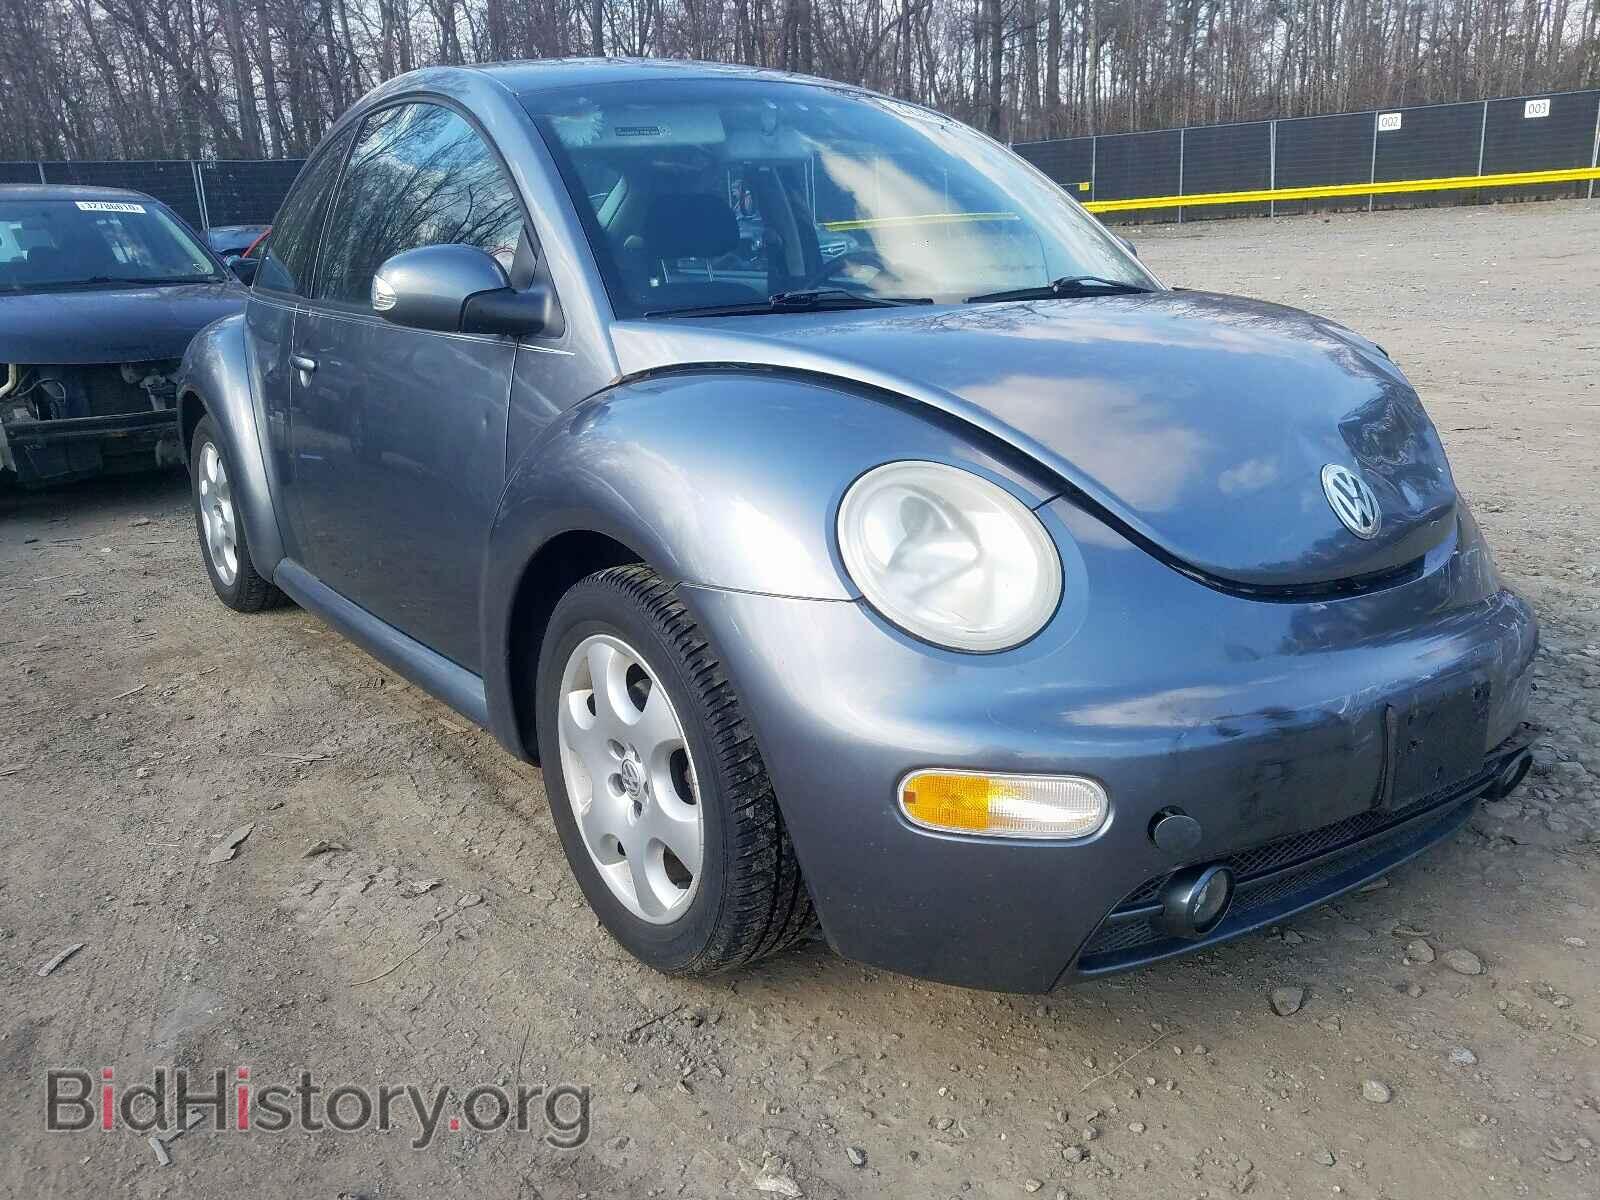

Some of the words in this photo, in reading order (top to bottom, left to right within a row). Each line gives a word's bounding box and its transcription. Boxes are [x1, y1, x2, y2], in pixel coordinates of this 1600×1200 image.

[1528, 102, 1547, 115] 003
[1381, 116, 1399, 128] 002
[1323, 465, 1380, 538] VW
